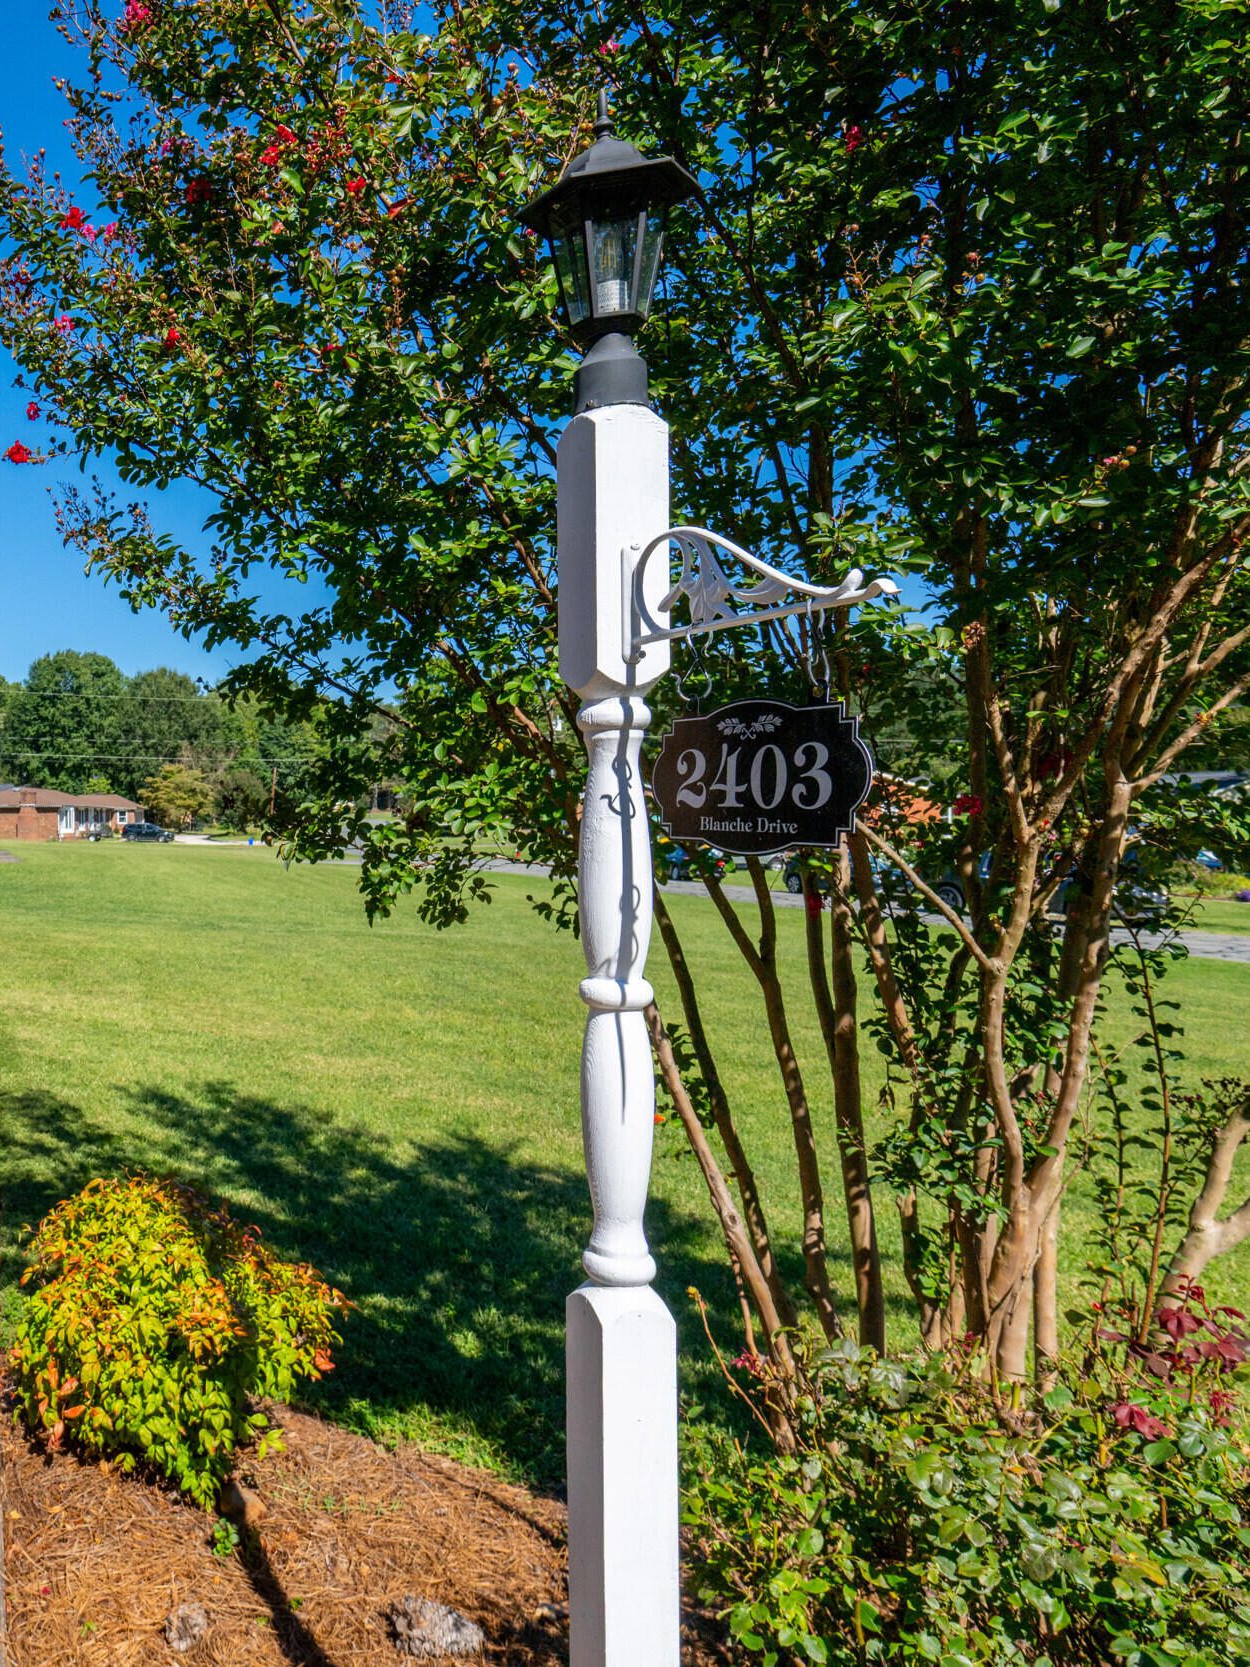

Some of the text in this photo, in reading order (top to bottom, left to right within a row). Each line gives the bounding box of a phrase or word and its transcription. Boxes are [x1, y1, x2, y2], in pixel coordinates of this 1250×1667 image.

[676, 741, 833, 810] 2403
[699, 816, 798, 834] Blanche Drive
